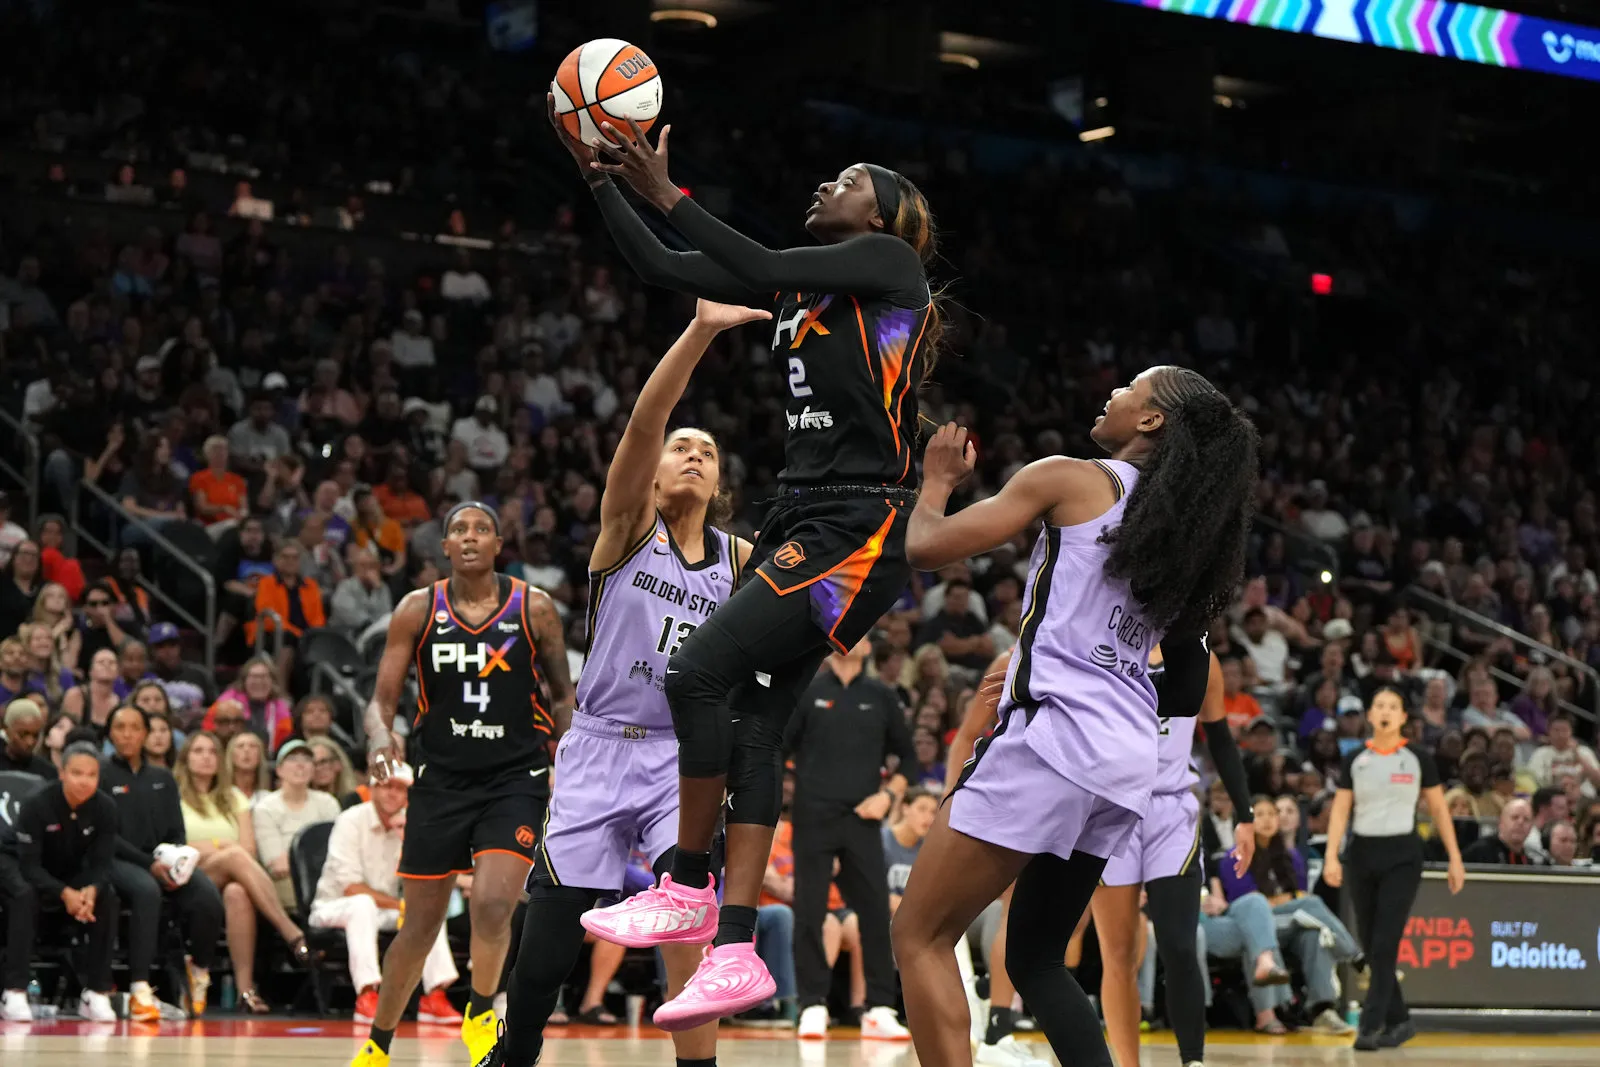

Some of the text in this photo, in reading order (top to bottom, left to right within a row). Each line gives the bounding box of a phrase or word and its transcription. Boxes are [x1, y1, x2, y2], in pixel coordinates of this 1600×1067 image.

[787, 357, 813, 398] 2
[632, 570, 720, 617] GOLDEN STA
[432, 636, 518, 678] PHX
[463, 681, 491, 713] 4
[624, 726, 647, 740] GSV
[1522, 922, 1538, 937] BY
[1397, 938, 1475, 969] APP
[1492, 941, 1586, 970] Deloitte.
